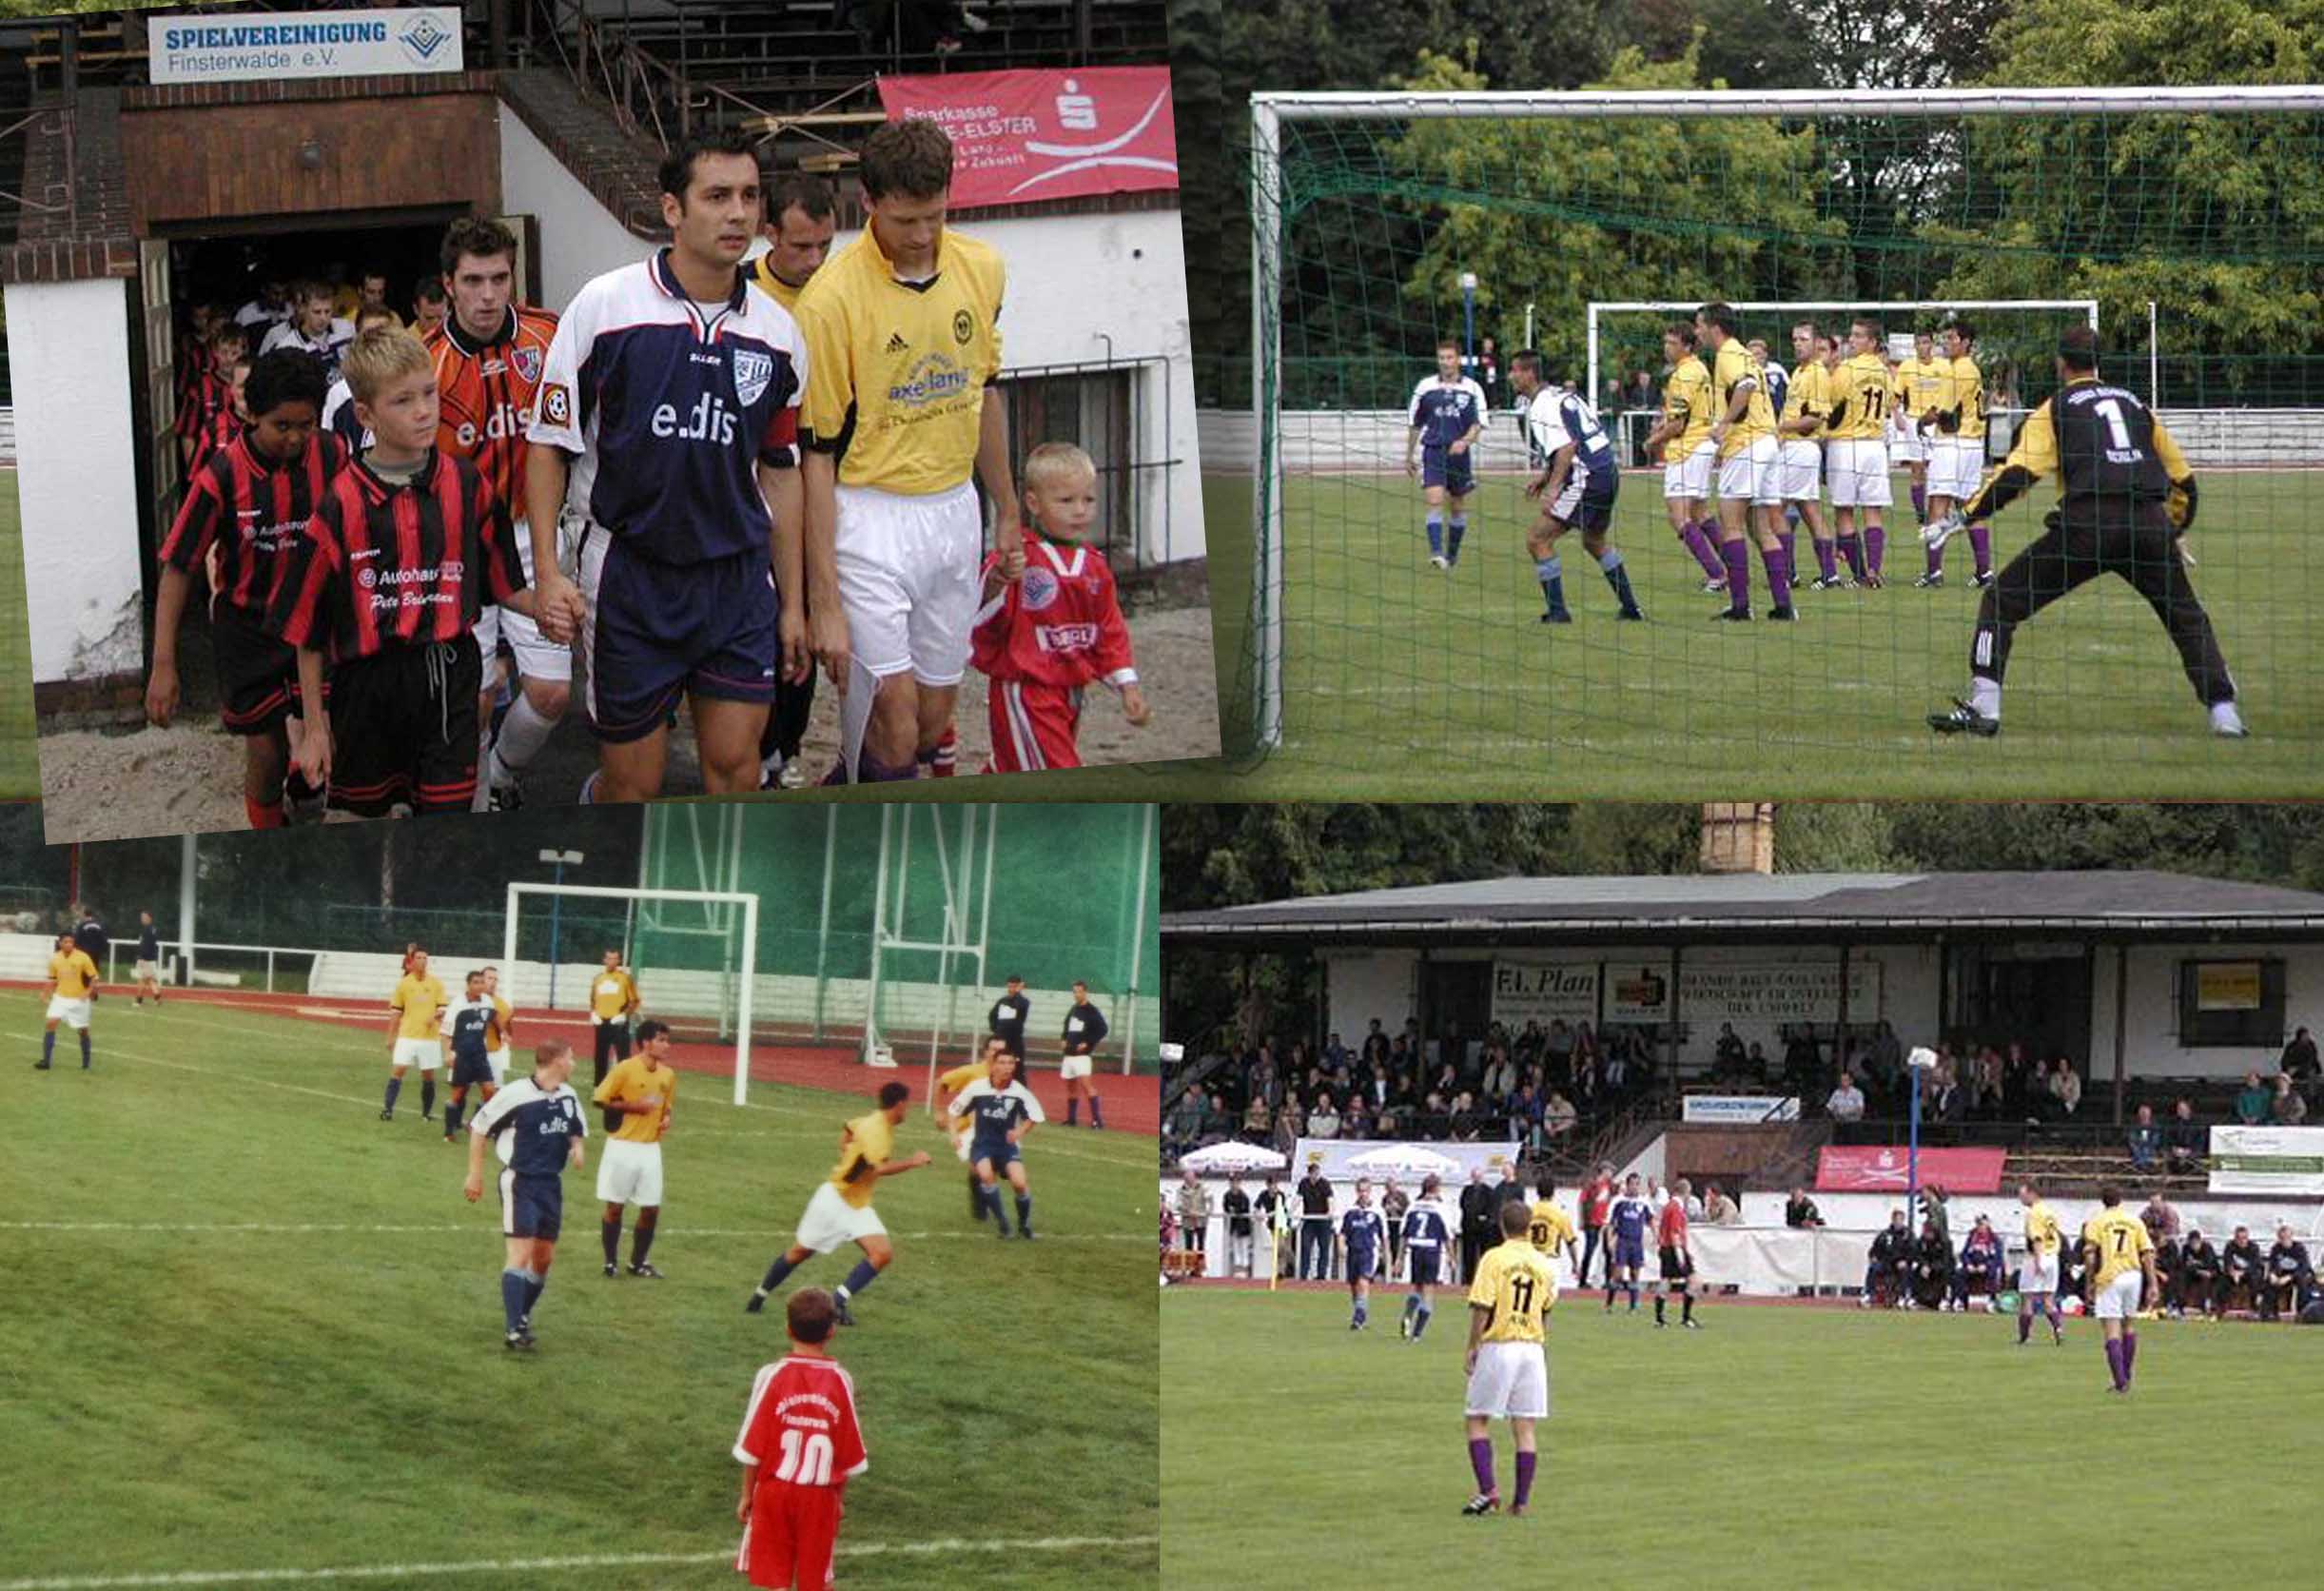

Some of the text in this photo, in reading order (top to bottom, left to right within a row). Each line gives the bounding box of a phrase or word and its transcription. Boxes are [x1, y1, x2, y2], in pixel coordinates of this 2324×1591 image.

[166, 21, 386, 49] SPIELVEREINIGUNG
[167, 49, 339, 73] Finsterwalde e.V.
[652, 392, 738, 446] e.dis
[1863, 386, 1884, 421] 11
[458, 403, 533, 446] e.dis
[2095, 399, 2131, 449] 1
[1537, 969, 1594, 992] Plan
[539, 1116, 568, 1135] e.dis
[2113, 1228, 2127, 1252] 7
[1512, 1276, 1533, 1314] 11
[775, 1428, 833, 1486] 10
